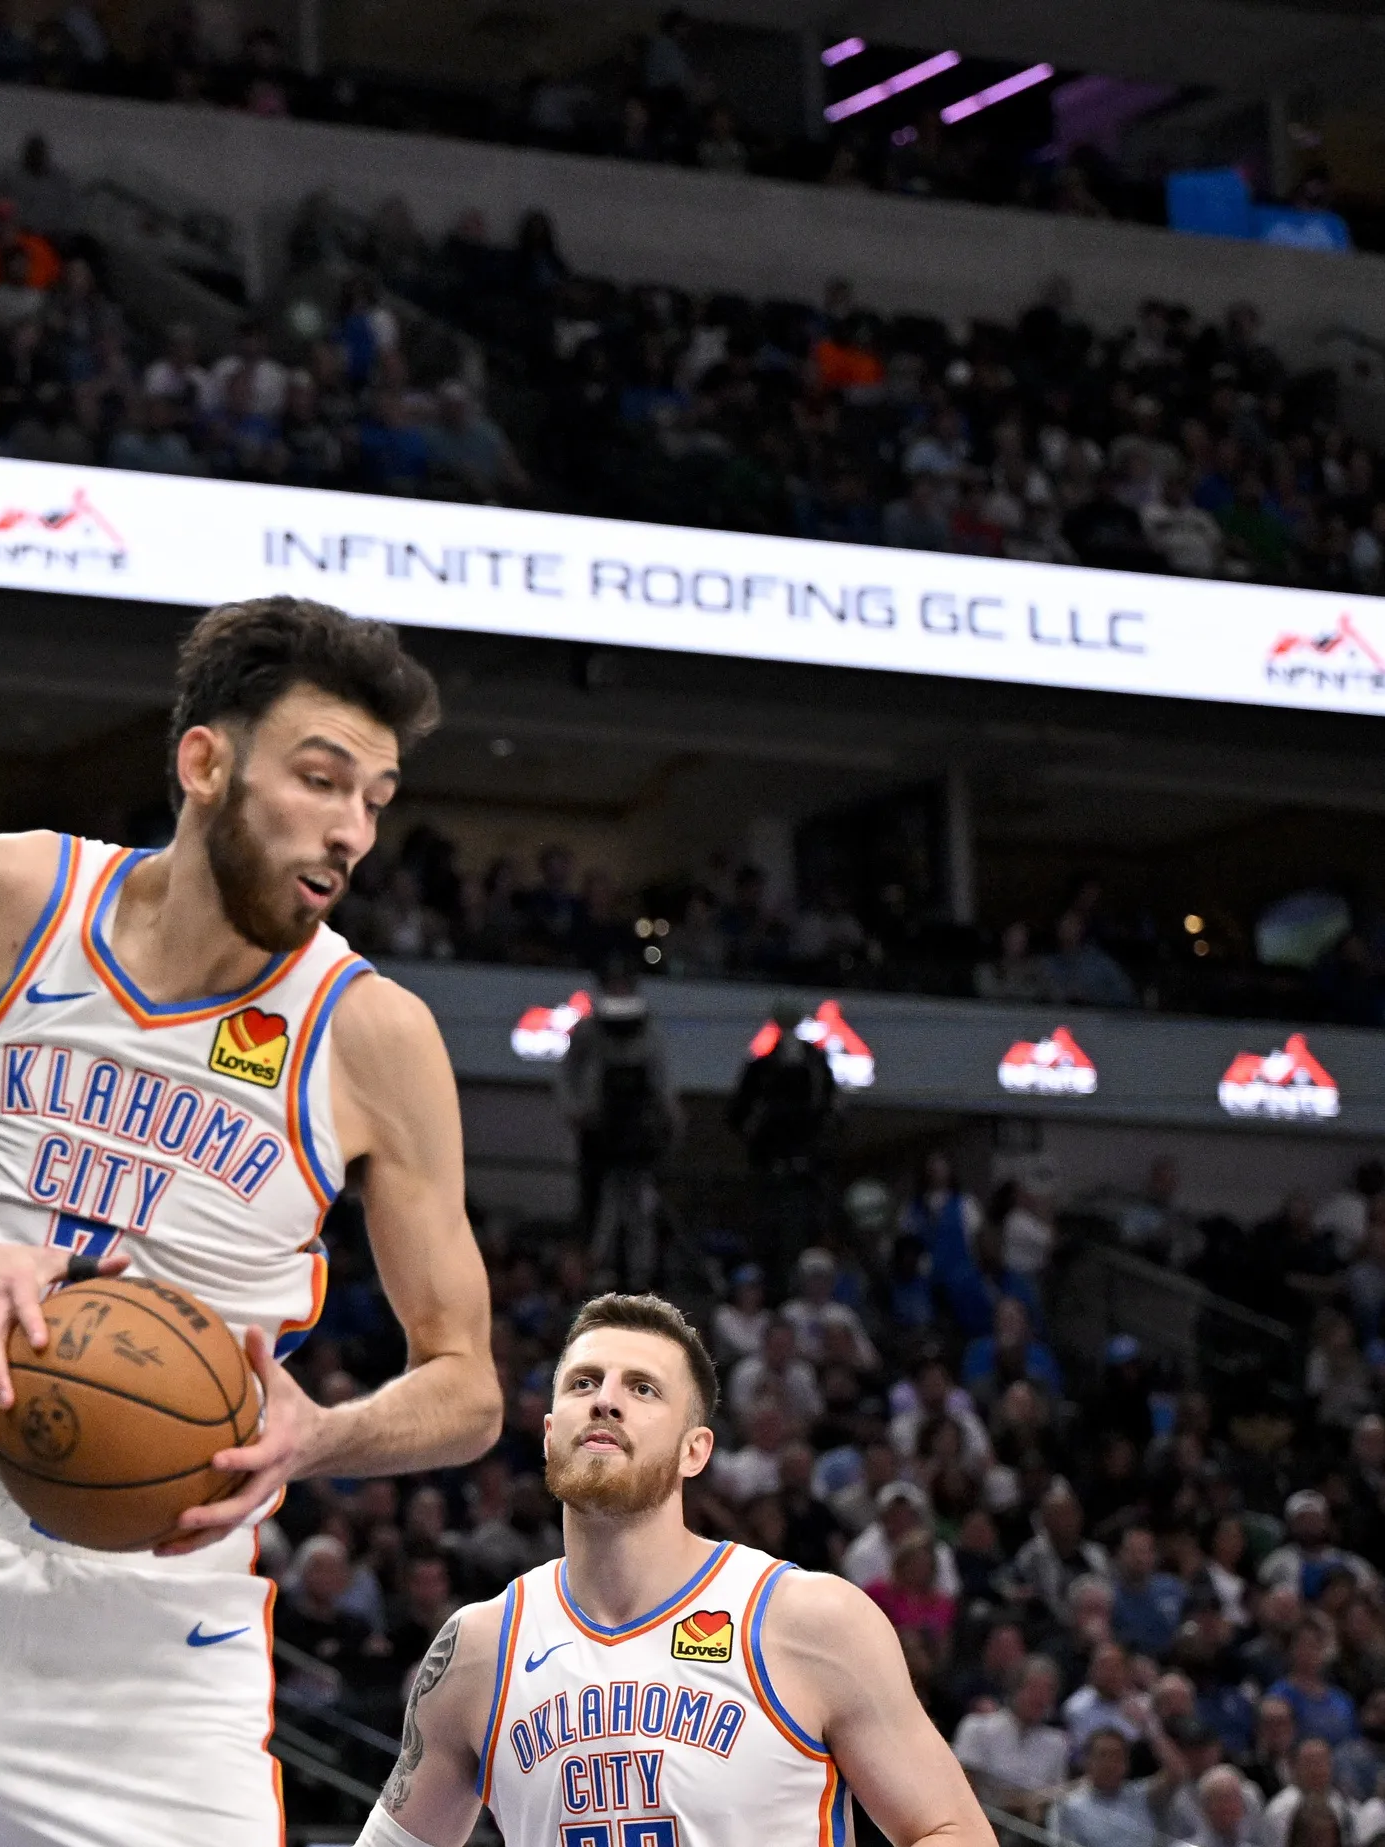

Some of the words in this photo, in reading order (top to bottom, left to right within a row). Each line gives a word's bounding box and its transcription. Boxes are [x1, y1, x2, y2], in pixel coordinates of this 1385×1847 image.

[264, 527, 561, 595] INFINITE
[590, 559, 894, 629] ROOFING
[920, 592, 1004, 640] GC
[1027, 605, 1148, 654] LLC
[28, 1133, 175, 1233] CITY
[511, 1682, 746, 1774] OKLAHOMA
[562, 1750, 664, 1814] CITY
